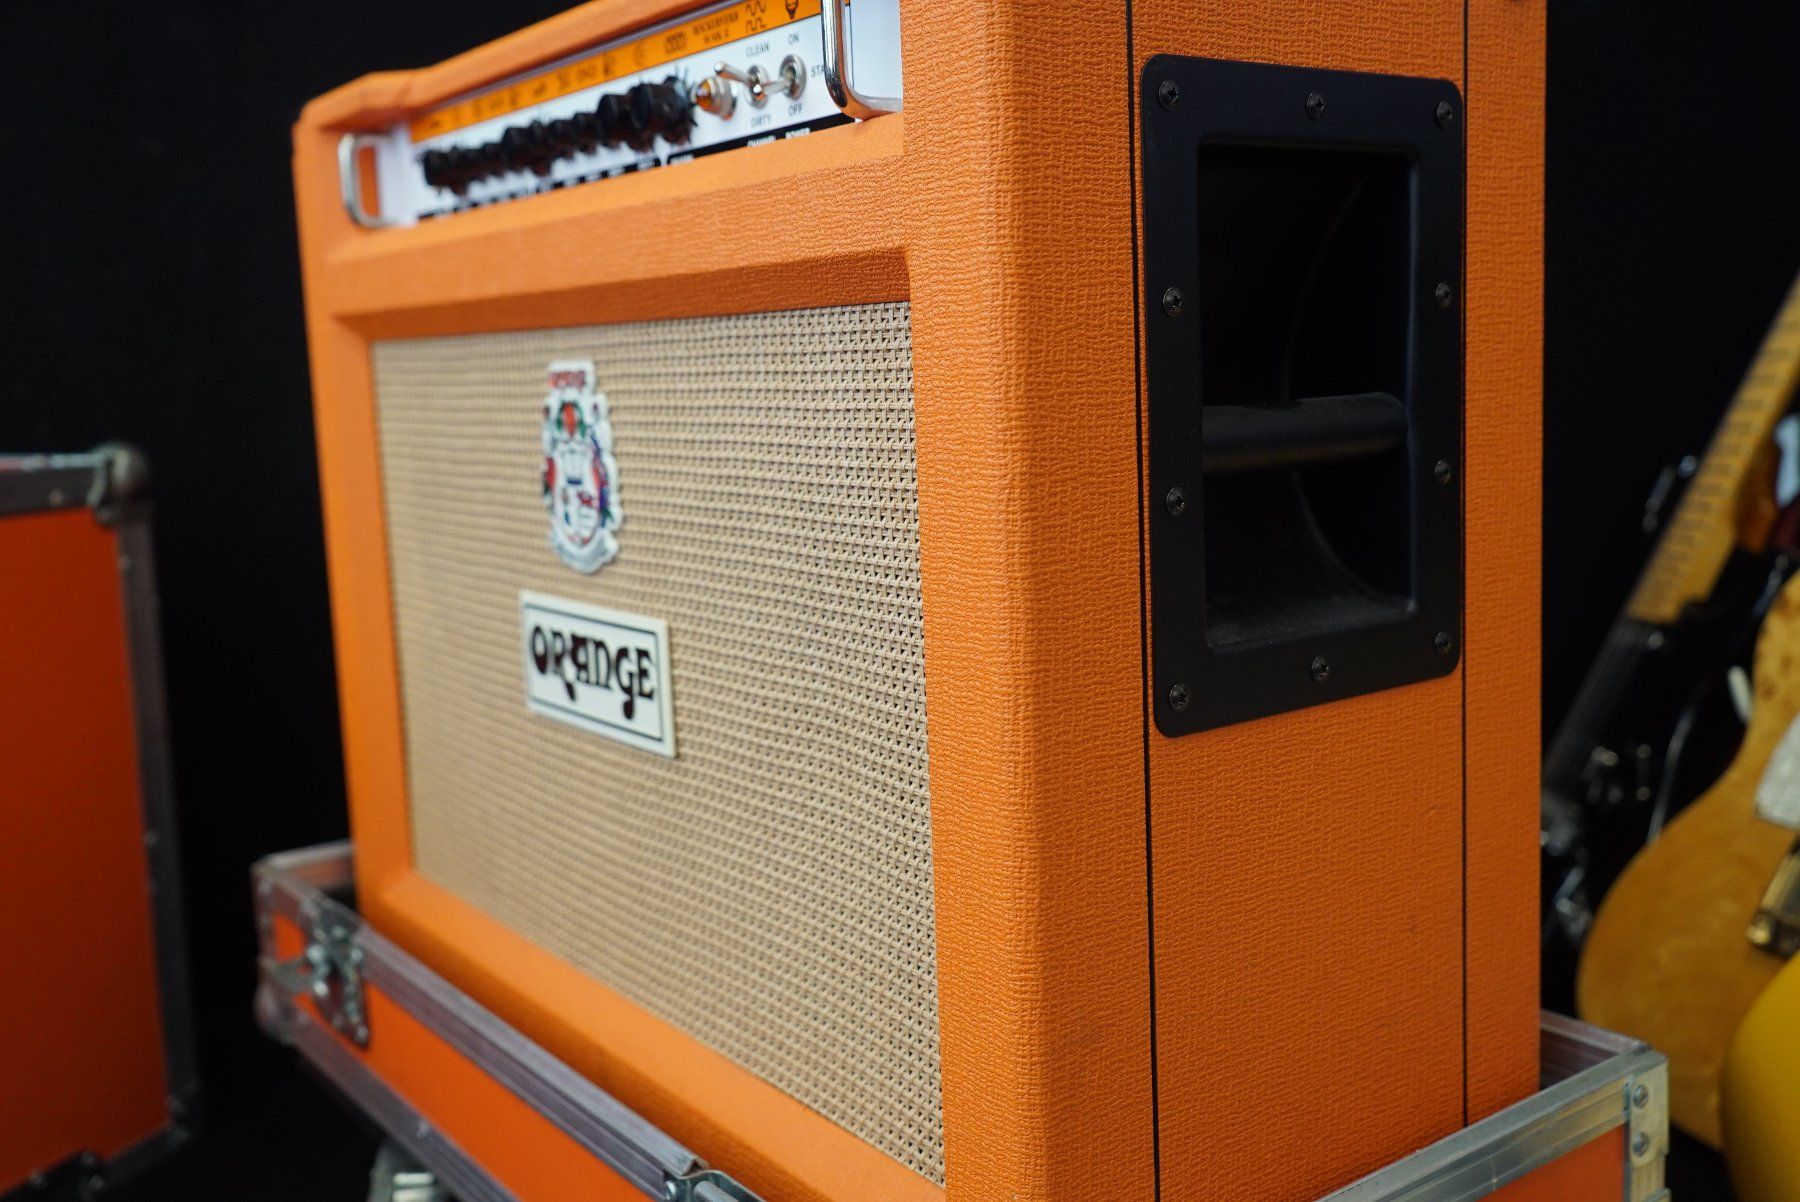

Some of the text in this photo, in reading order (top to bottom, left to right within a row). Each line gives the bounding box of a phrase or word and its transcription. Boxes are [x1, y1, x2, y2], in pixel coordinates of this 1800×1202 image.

[788, 33, 799, 44] ON
[746, 42, 769, 57] CLEAN
[788, 103, 802, 116] OFF
[751, 113, 771, 127] DIRTY
[532, 625, 654, 720] ORANGE
